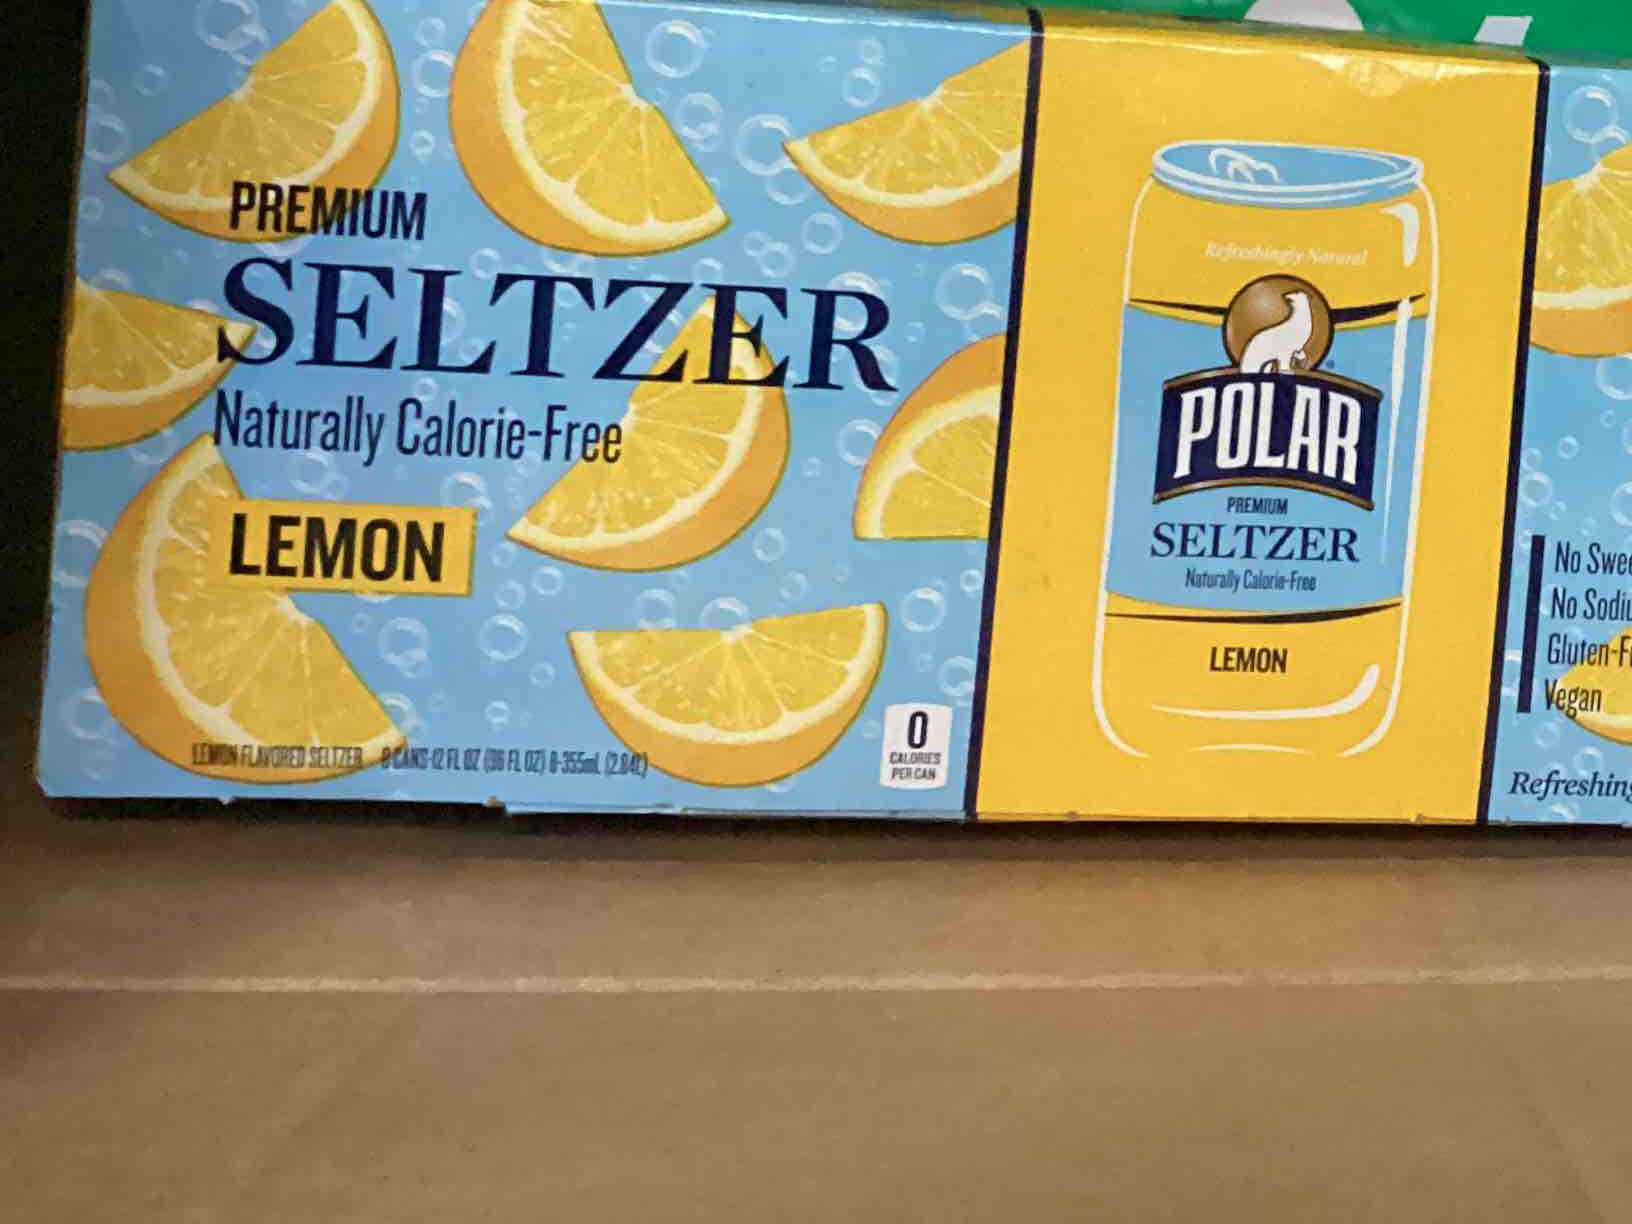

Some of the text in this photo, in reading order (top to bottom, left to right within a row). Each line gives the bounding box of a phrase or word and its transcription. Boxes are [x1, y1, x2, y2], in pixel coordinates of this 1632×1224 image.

[230, 181, 427, 240] PREMIUM
[1204, 239, 1370, 267] Refreshingly Natural
[217, 257, 898, 393] SELTZER
[214, 388, 622, 468] Naturally Calorie-Free
[1172, 380, 1362, 486] POLAR
[1226, 496, 1289, 517] PREMIUM
[228, 513, 445, 583] LEMON
[1150, 522, 1360, 564] SELTZER
[1555, 540, 1581, 575] No
[1185, 568, 1318, 594] Naturally Calorie-Free
[1550, 587, 1577, 620] No
[1209, 645, 1289, 674] LEMON
[1544, 679, 1602, 719] Vegan
[907, 711, 929, 750] 0
[192, 742, 365, 769] LEMON FLAVORED SELTZER
[446, 748, 461, 771] FL
[507, 750, 522, 772] FL
[524, 750, 547, 774] OZ)
[889, 750, 942, 767] CALORIES
[890, 766, 938, 782] PER CAN
